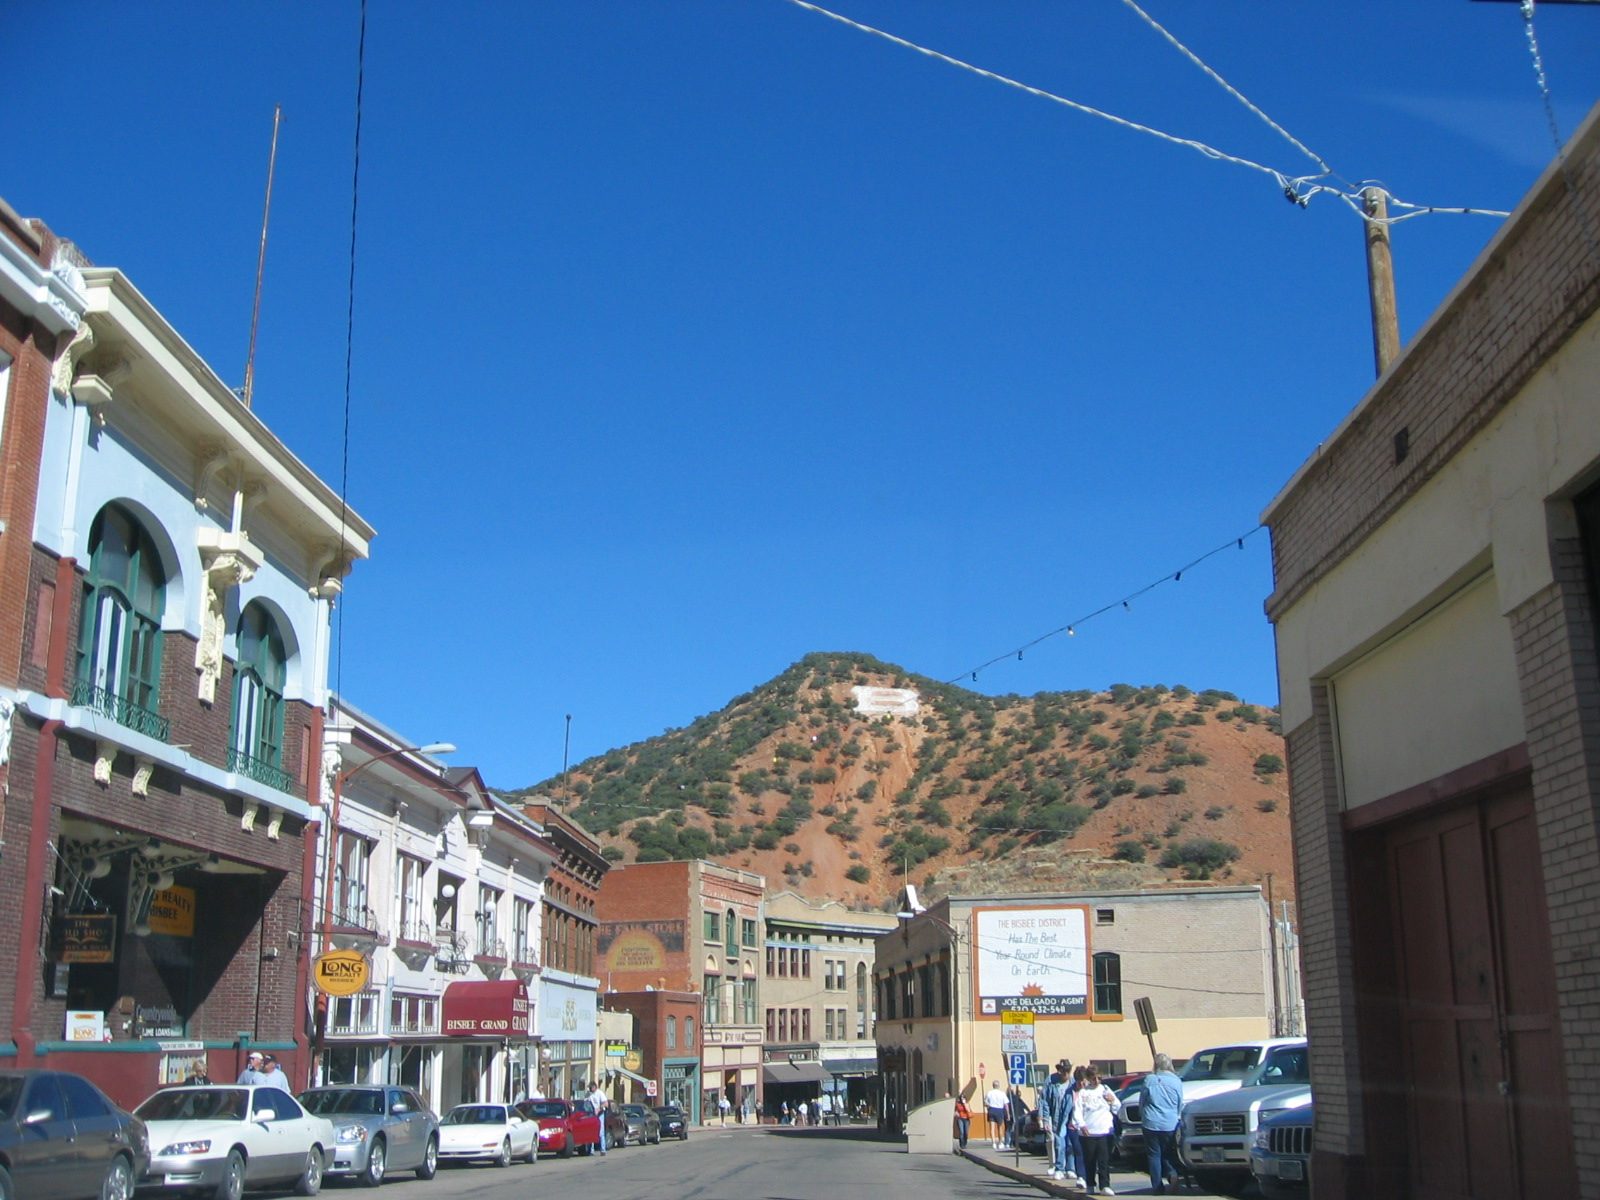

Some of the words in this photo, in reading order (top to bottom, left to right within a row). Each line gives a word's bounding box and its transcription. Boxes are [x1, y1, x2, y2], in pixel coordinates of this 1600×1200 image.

[999, 919, 1009, 928] THE
[1011, 919, 1035, 928] BISBEE
[1038, 918, 1067, 928] DISTRICT
[1008, 934, 1022, 944] Has
[1025, 932, 1038, 943] The
[1040, 932, 1057, 943] Best
[995, 949, 1011, 960] Year
[1015, 948, 1040, 960] Round
[1043, 947, 1072, 959] Climate
[321, 961, 363, 977] LONG
[1011, 965, 1021, 976] On
[1026, 964, 1050, 976] Earth
[513, 998, 528, 1012] BISBEE
[1002, 998, 1018, 1006] JOE
[1020, 997, 1056, 1006] DELGADO
[1061, 997, 1085, 1005] AGENT
[447, 1020, 477, 1030] BISBEE
[480, 1020, 508, 1030] GRAND
[512, 1016, 528, 1031] GRAND
[1014, 1056, 1022, 1068] P
